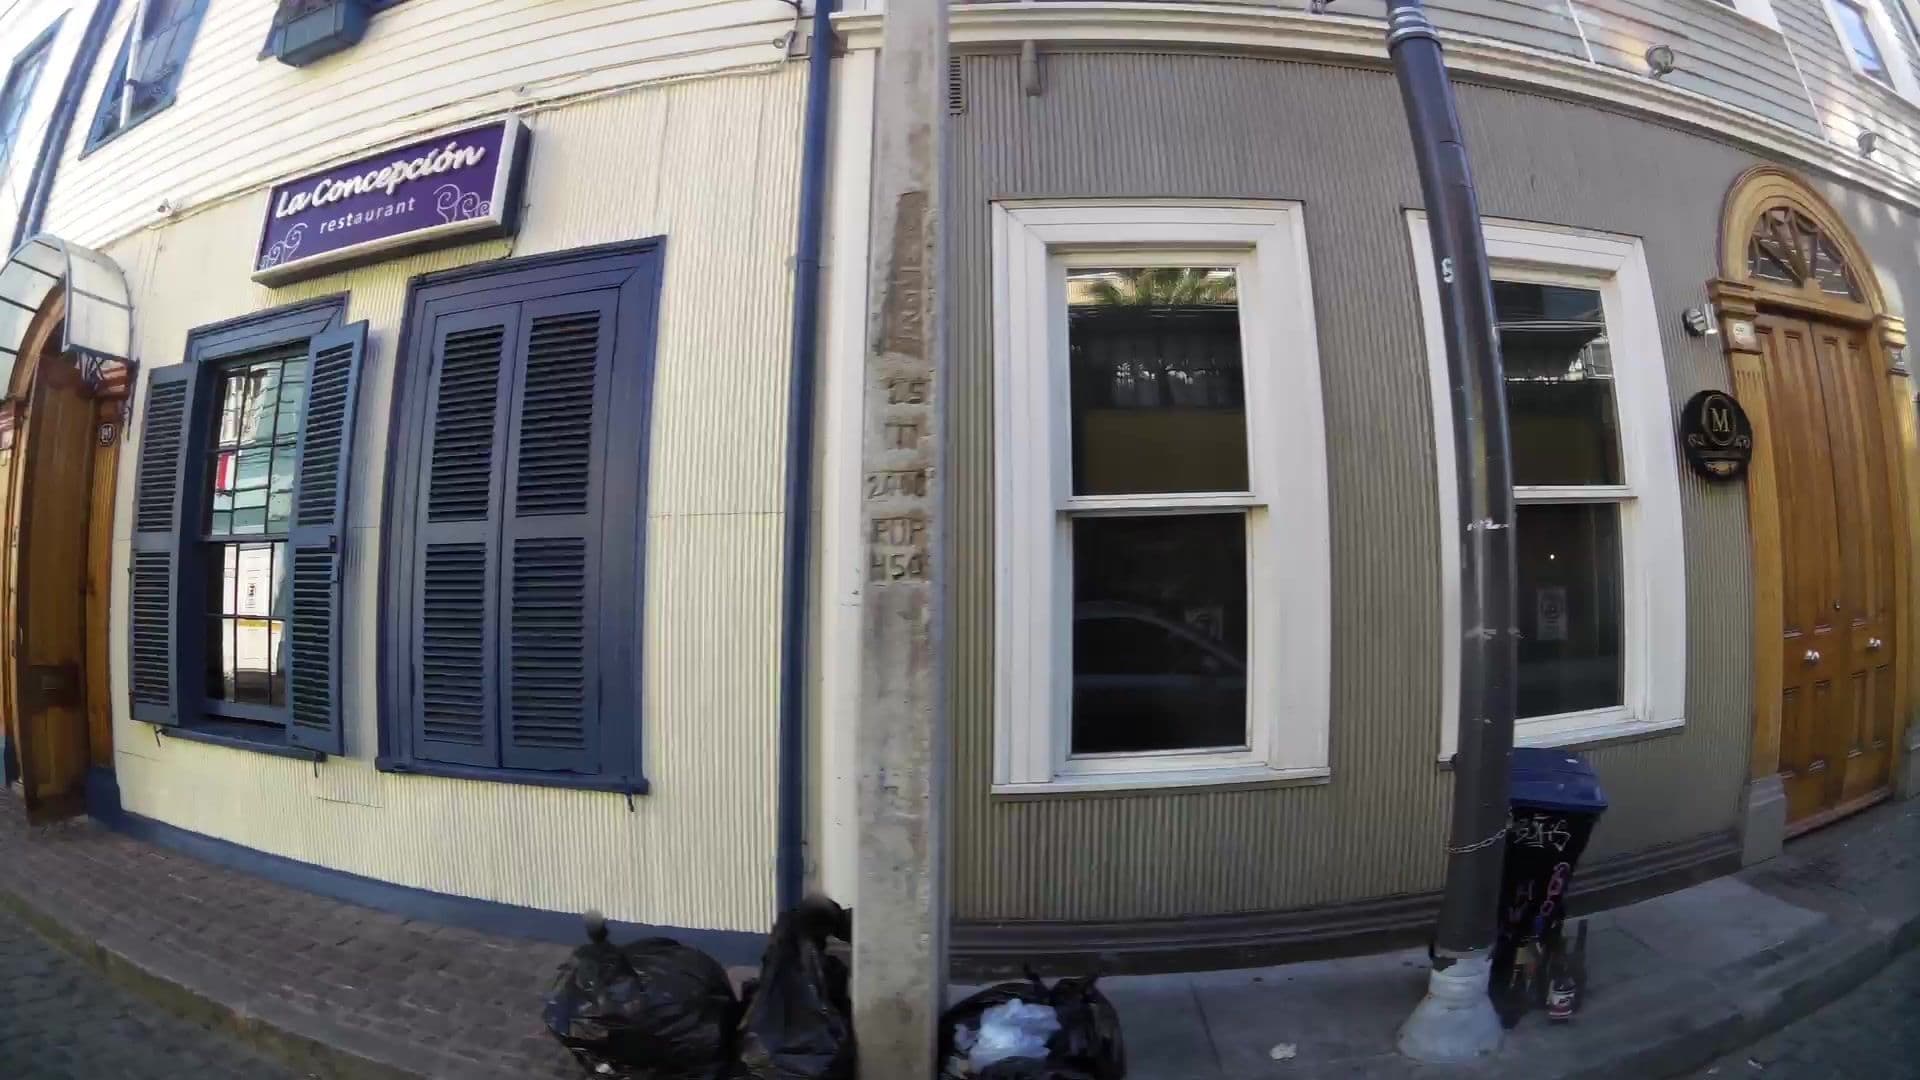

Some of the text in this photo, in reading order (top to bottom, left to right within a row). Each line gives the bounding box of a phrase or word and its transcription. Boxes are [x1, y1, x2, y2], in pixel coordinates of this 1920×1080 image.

[275, 141, 485, 219] La Concepción
[318, 197, 416, 235] restaurant
